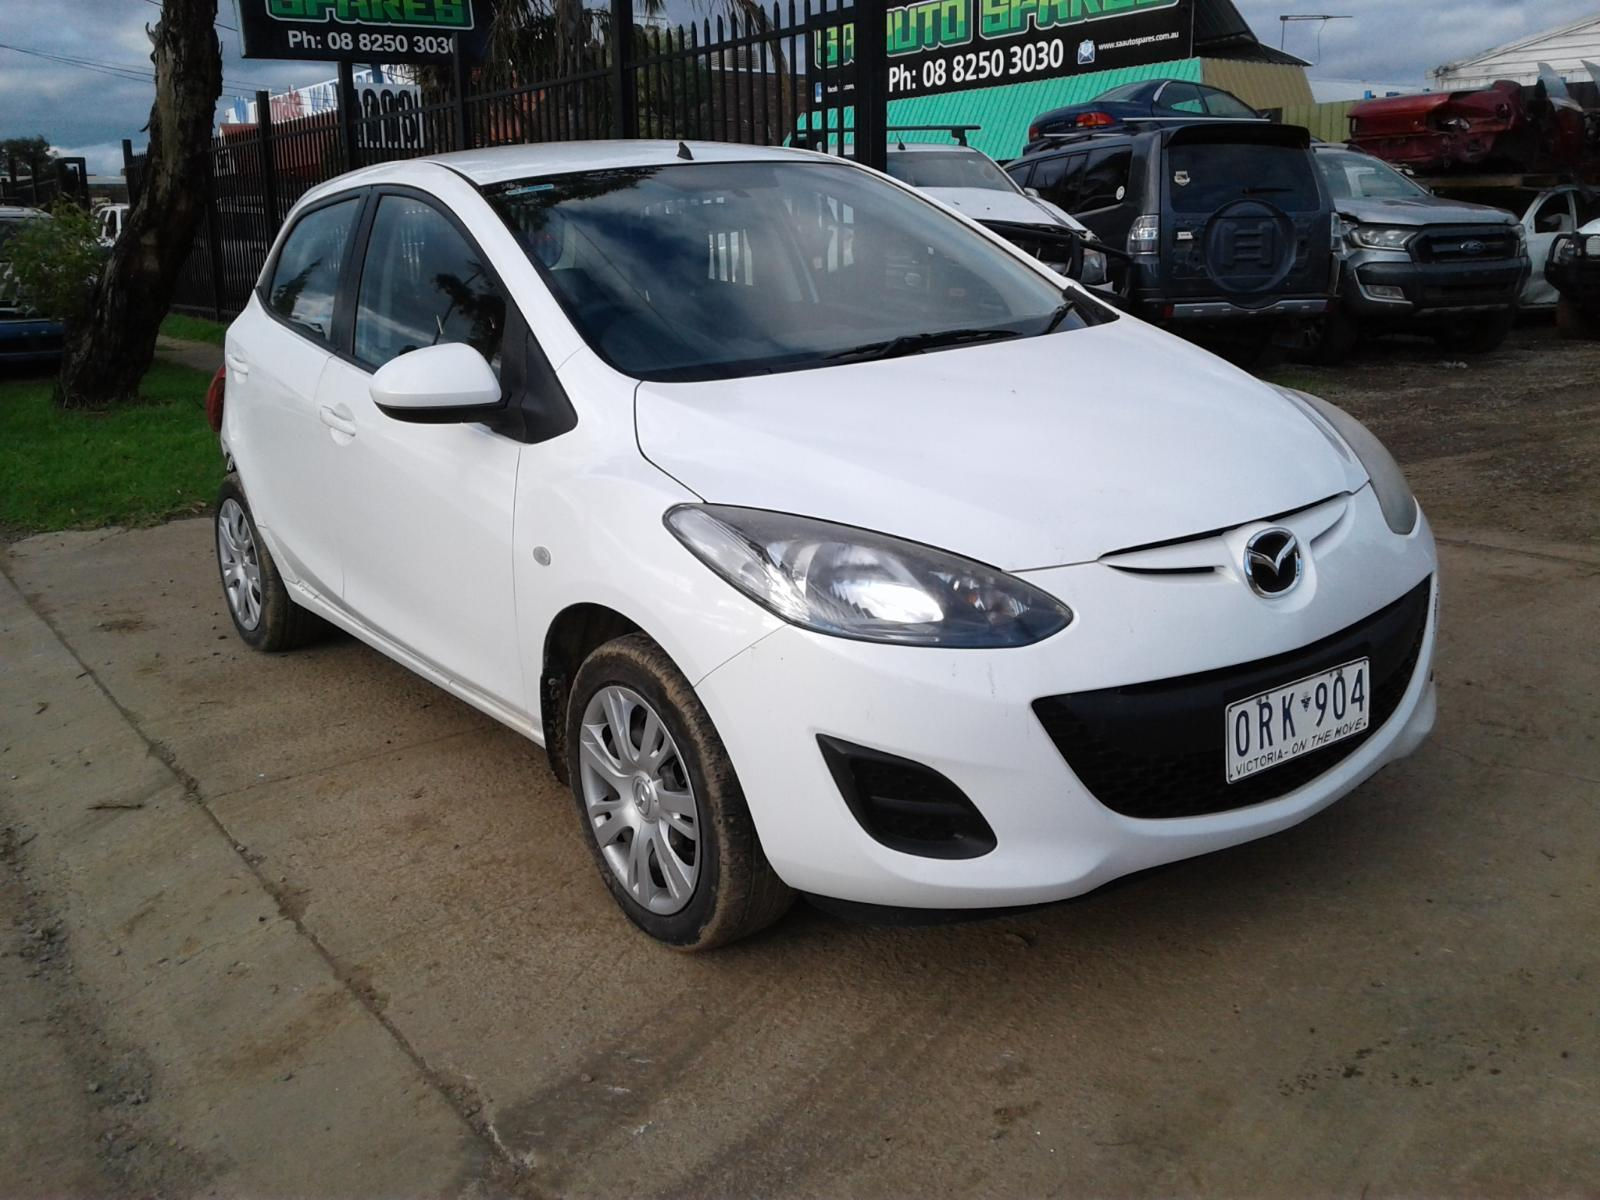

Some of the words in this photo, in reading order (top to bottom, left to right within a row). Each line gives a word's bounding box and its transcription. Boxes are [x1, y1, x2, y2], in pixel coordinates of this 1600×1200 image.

[288, 30, 322, 49] Ph:
[327, 32, 354, 50] 08
[358, 33, 409, 53] 8250
[886, 0, 970, 54] UTO
[982, 0, 1176, 35] SPAR
[888, 64, 917, 93] Ph:
[922, 59, 947, 88] 08
[952, 48, 1004, 83] 8250
[1009, 38, 1065, 75] 3030
[1235, 692, 1296, 758] ORK
[1314, 668, 1366, 728] 904
[1291, 739, 1307, 755] ON
[1311, 727, 1332, 748] THE
[1334, 717, 1364, 738] MOVE
